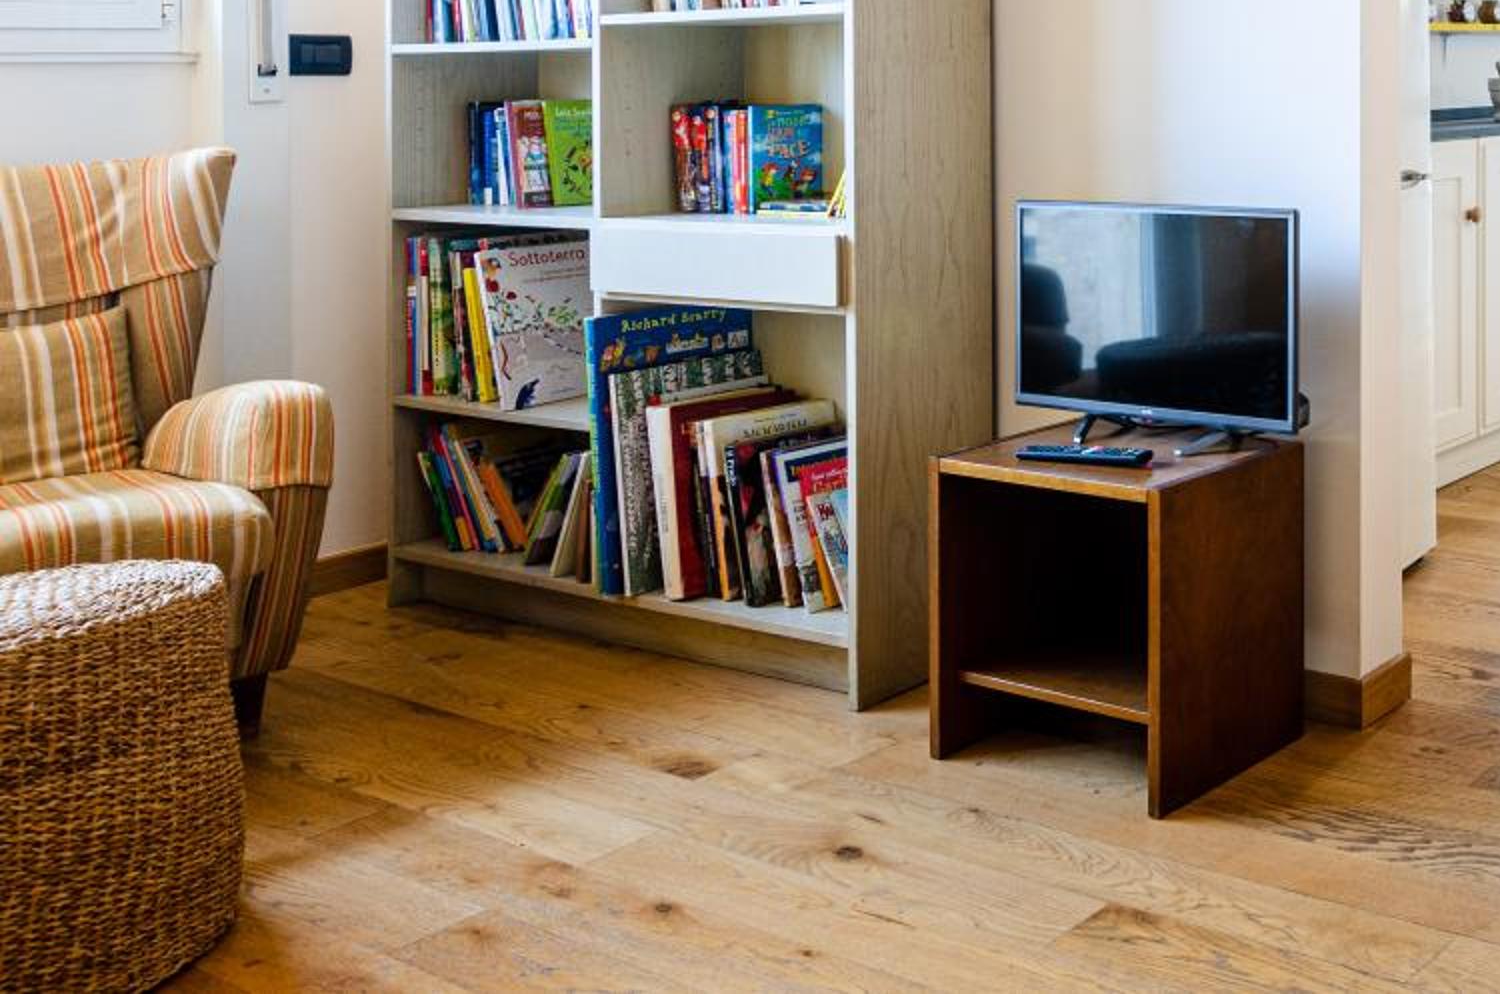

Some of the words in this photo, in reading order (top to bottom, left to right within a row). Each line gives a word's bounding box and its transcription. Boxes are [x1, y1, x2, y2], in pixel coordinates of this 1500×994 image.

[510, 249, 585, 267] Sottoterra
[621, 313, 676, 333] Richard
[681, 308, 727, 324] Scarry
